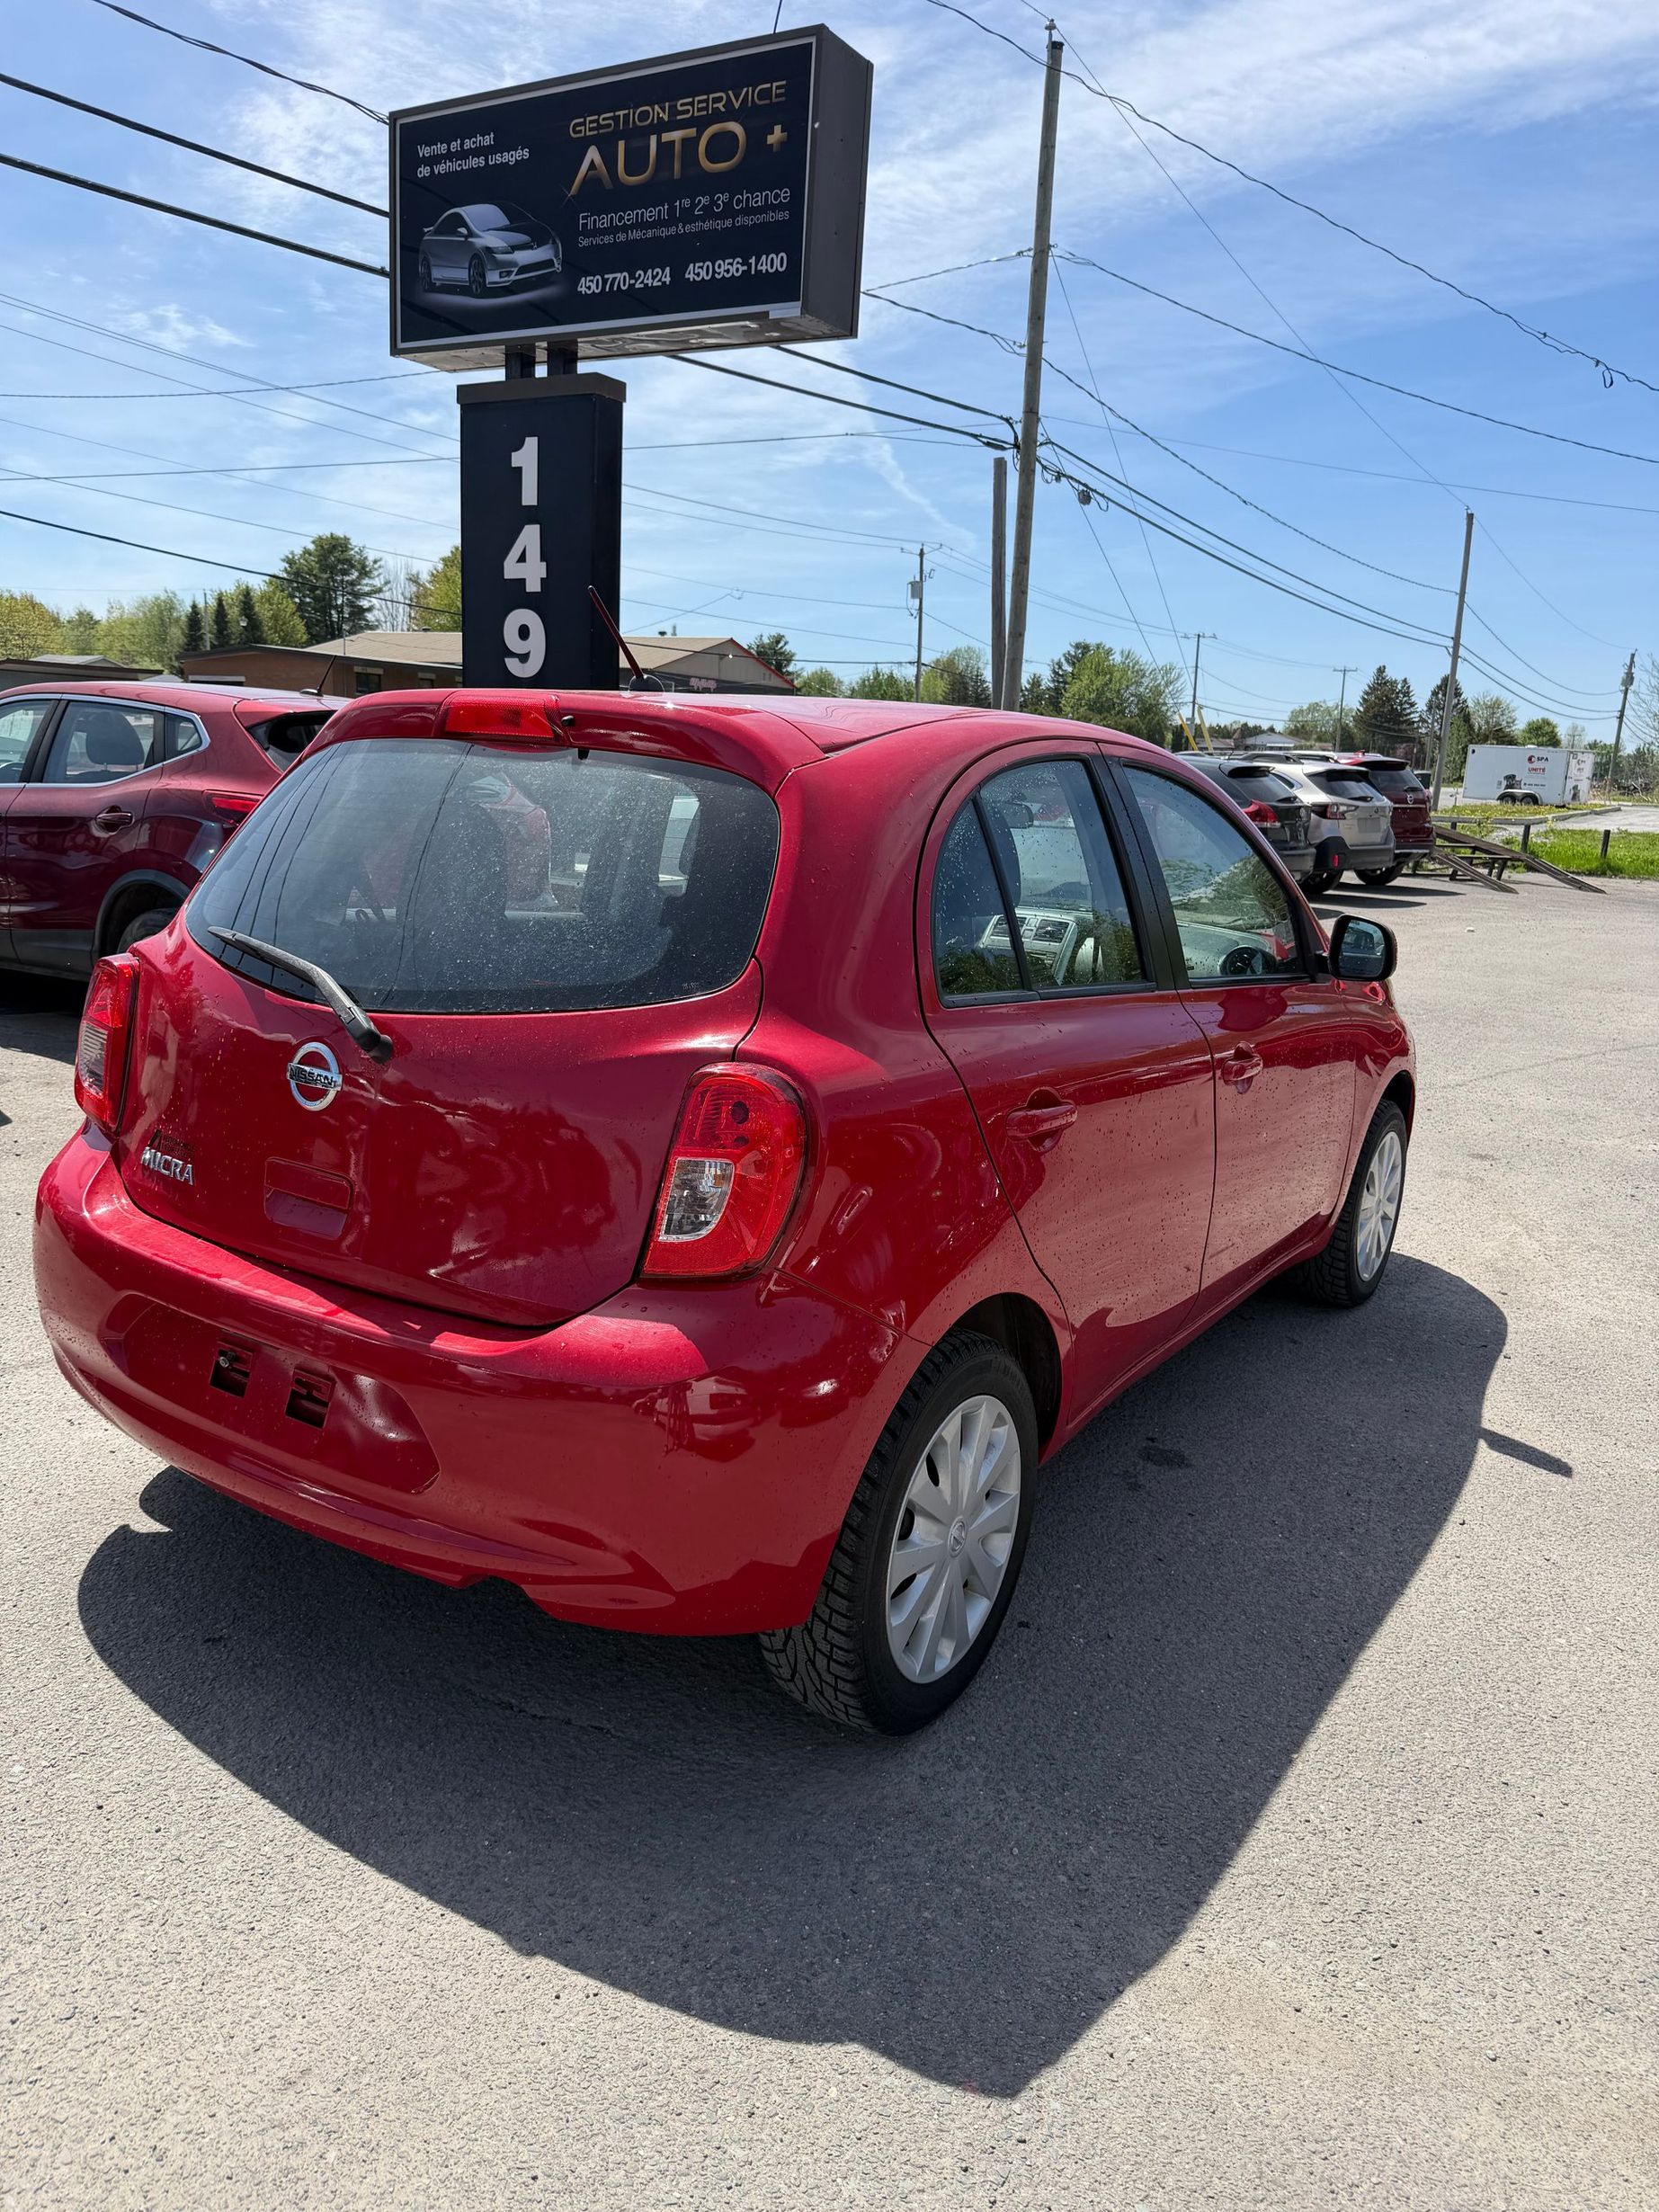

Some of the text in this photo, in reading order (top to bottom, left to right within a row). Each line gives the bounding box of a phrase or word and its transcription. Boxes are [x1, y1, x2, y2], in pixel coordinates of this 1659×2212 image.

[569, 80, 787, 138] GESTION SERVICE
[416, 146, 530, 178] de véhicules usagés
[417, 131, 495, 158] Vente et achat
[570, 120, 747, 196] AUTO
[577, 210, 790, 247] Services de Mécanique & esthétique disponibles
[578, 202, 669, 231] Financement
[694, 195, 710, 215] 2e
[713, 192, 730, 212] 3e
[733, 188, 790, 210] chance
[576, 252, 788, 295] 450 770-2424 450 956-1400
[289, 1065, 334, 1086] NISSAN
[140, 1146, 193, 1186] MICRA
